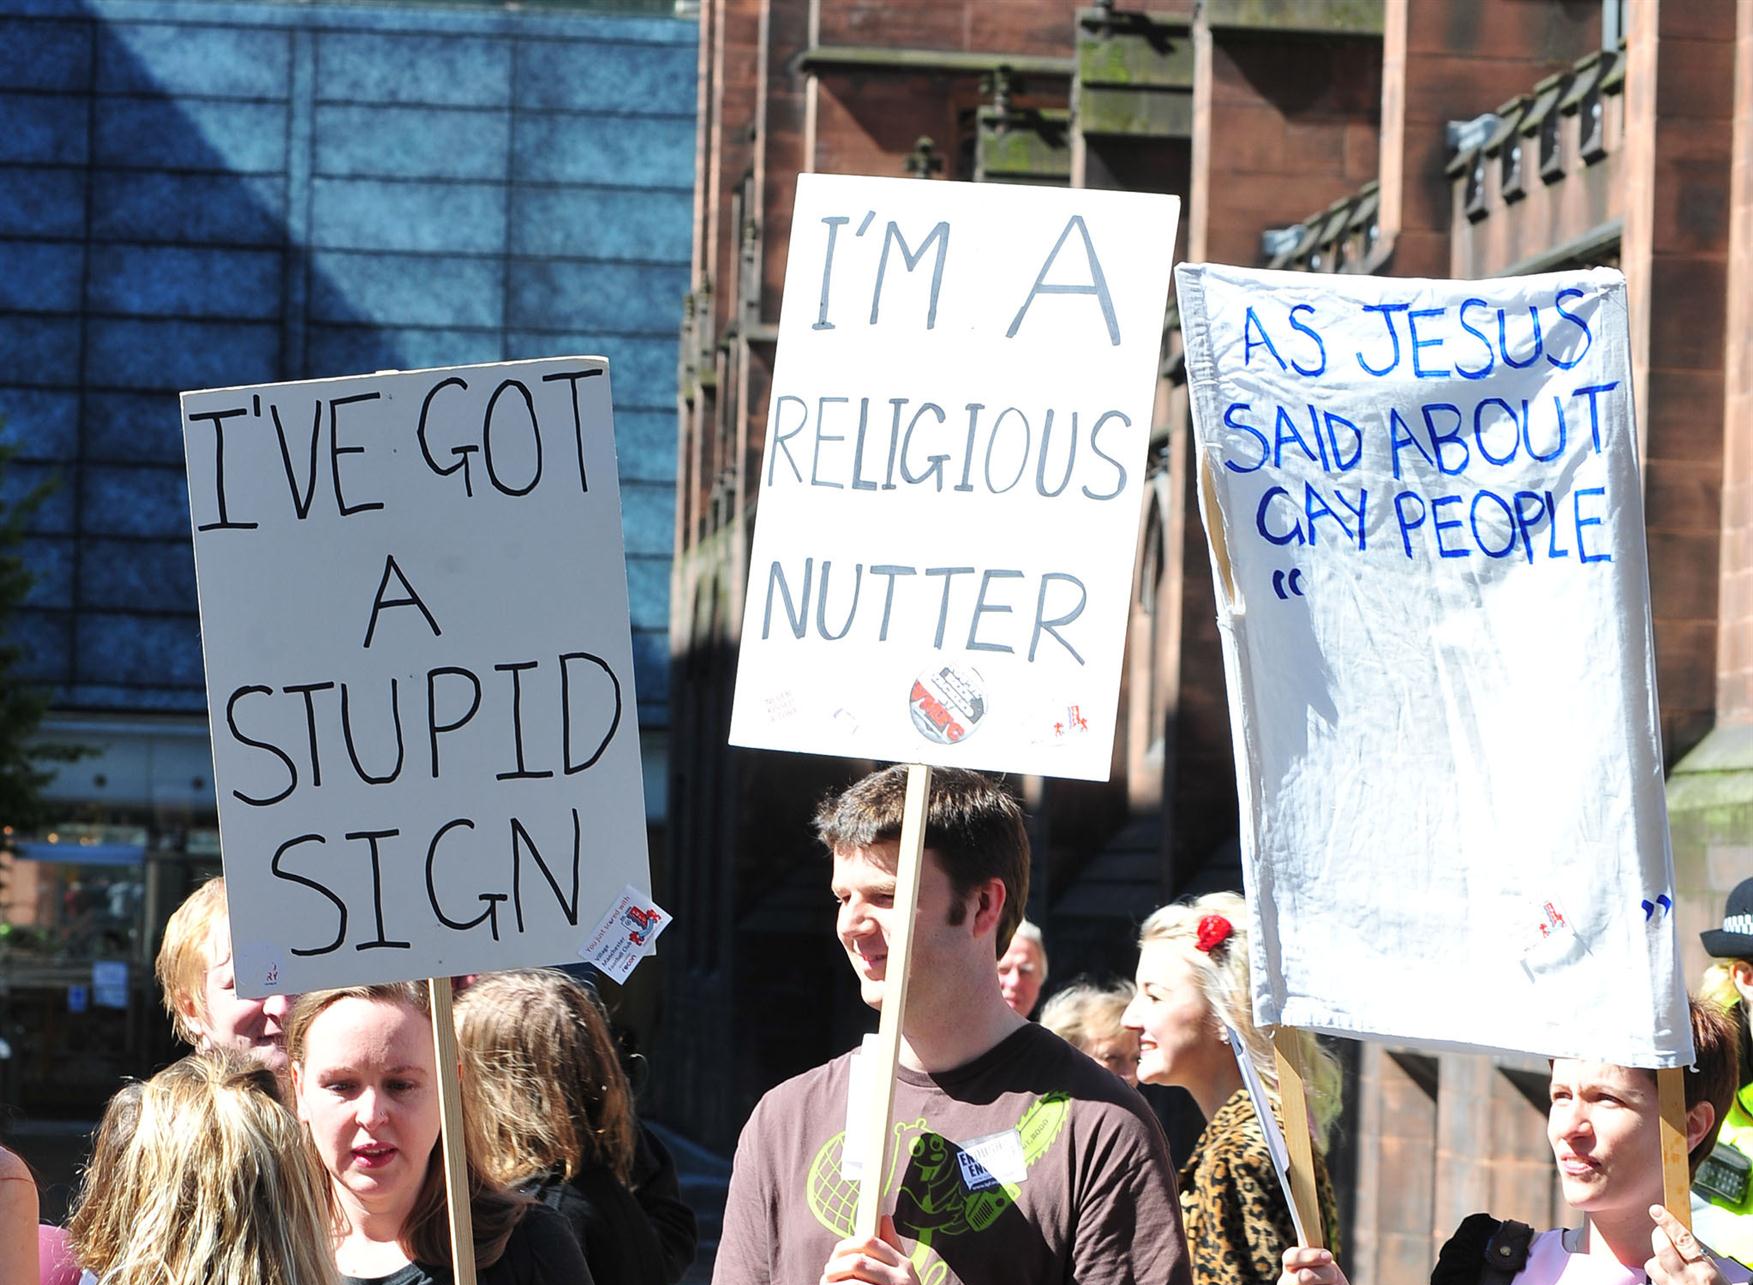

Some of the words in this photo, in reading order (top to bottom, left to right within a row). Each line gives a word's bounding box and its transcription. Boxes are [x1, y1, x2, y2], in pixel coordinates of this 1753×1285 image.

[811, 210, 951, 331] I'M
[1005, 214, 1121, 346] A
[1244, 303, 1328, 378] AS
[1356, 287, 1593, 381] JESUS
[189, 392, 384, 531] I'VE
[417, 368, 604, 498] GOT
[767, 395, 1132, 501] RELIGIOUS
[1223, 402, 1363, 474] SAID
[1389, 380, 1620, 481] ABOUT
[1256, 480, 1368, 552] GAY
[1393, 486, 1615, 565] PEOPLE
[363, 554, 442, 649] A
[761, 557, 1088, 667] NUTTER
[226, 652, 622, 807] STUPID
[271, 808, 581, 957] SIGN
